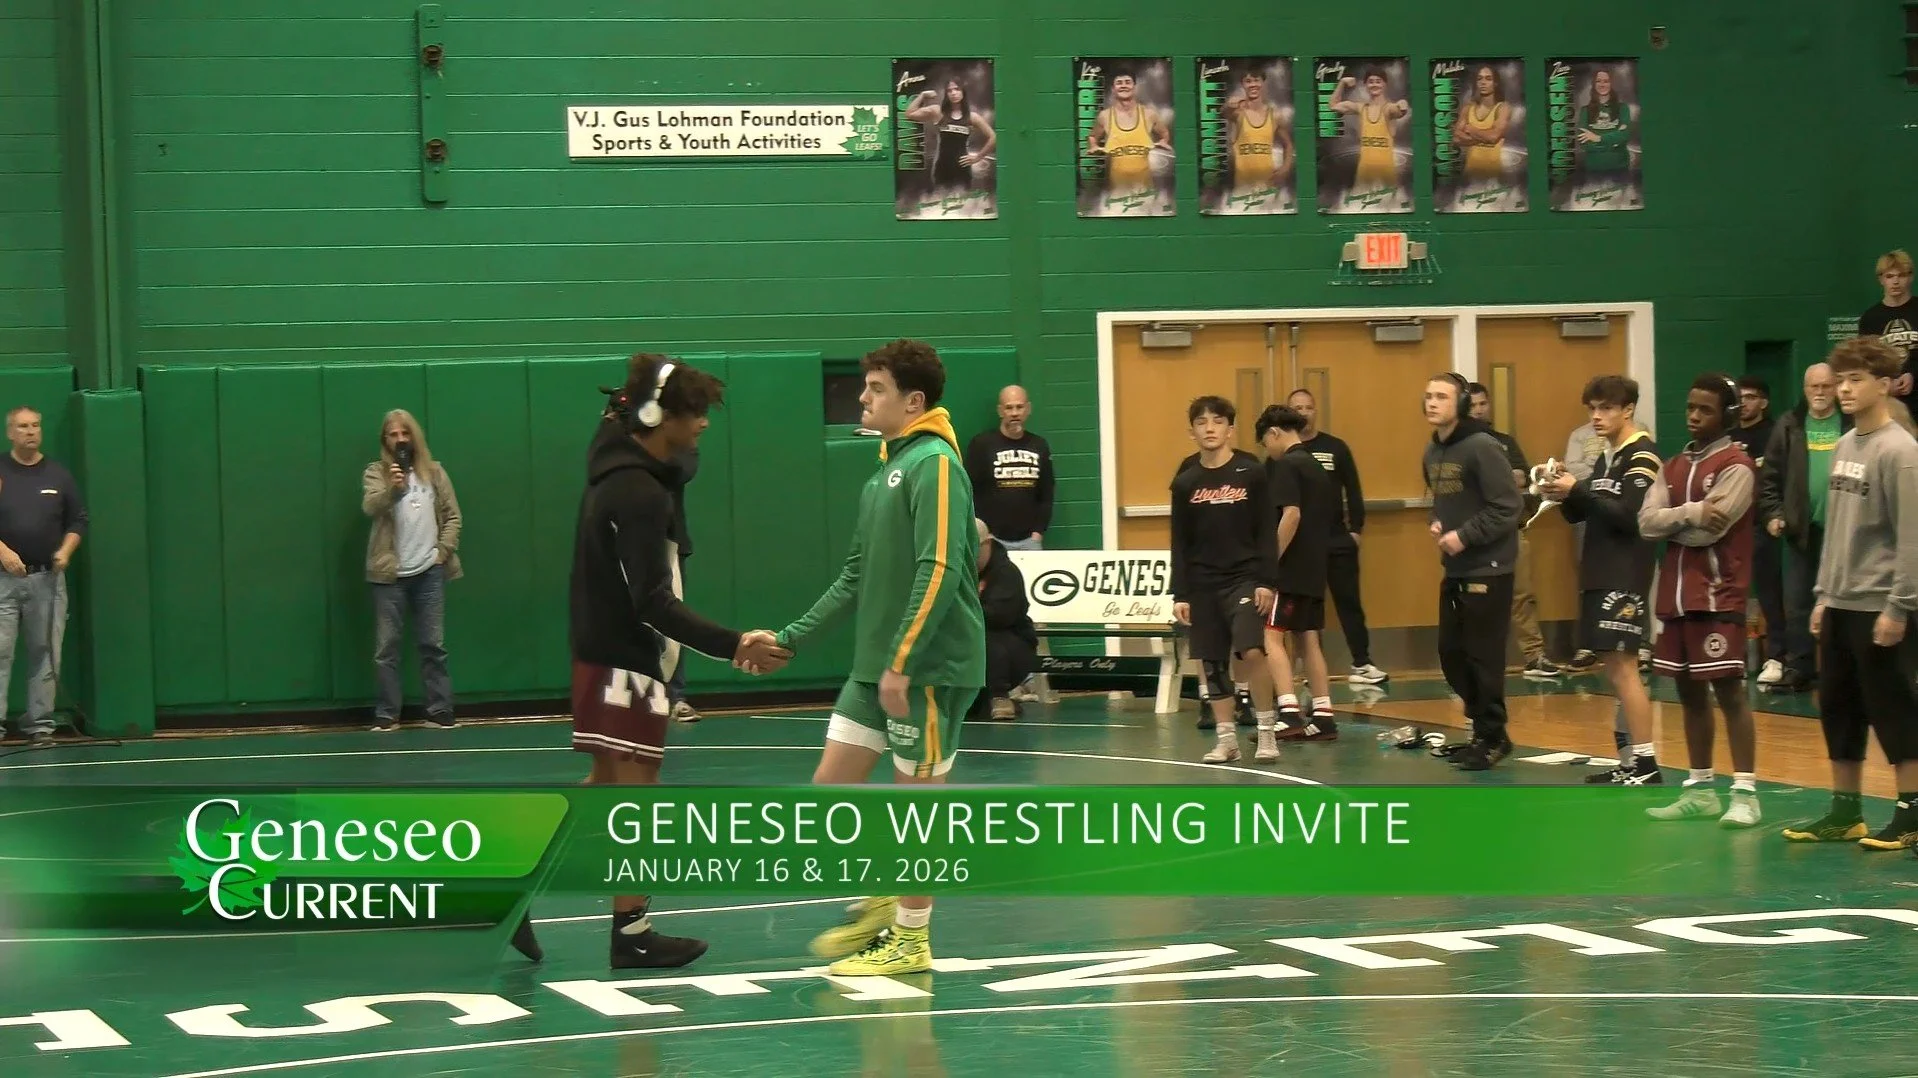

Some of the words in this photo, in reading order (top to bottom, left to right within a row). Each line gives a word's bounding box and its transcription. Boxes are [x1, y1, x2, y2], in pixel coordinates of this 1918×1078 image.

[573, 111, 606, 128] V.J.
[613, 110, 650, 127] Gus
[658, 110, 733, 127] Lohman
[741, 109, 845, 127] Foundation
[857, 124, 880, 132] LET'S
[862, 133, 877, 142] GO
[1548, 77, 1576, 184] NDERSEN
[592, 133, 652, 154] Sports
[659, 134, 672, 150] &
[677, 133, 730, 150] Youth
[736, 133, 821, 149] Activities
[1367, 235, 1400, 263] EXIT
[993, 449, 1039, 466] JOLIET
[887, 469, 902, 488] G
[1083, 559, 1174, 596] GENES
[1102, 601, 1121, 618] Go
[1125, 601, 1161, 621] Leafs
[1089, 657, 1117, 671] Only
[604, 668, 670, 716] M
